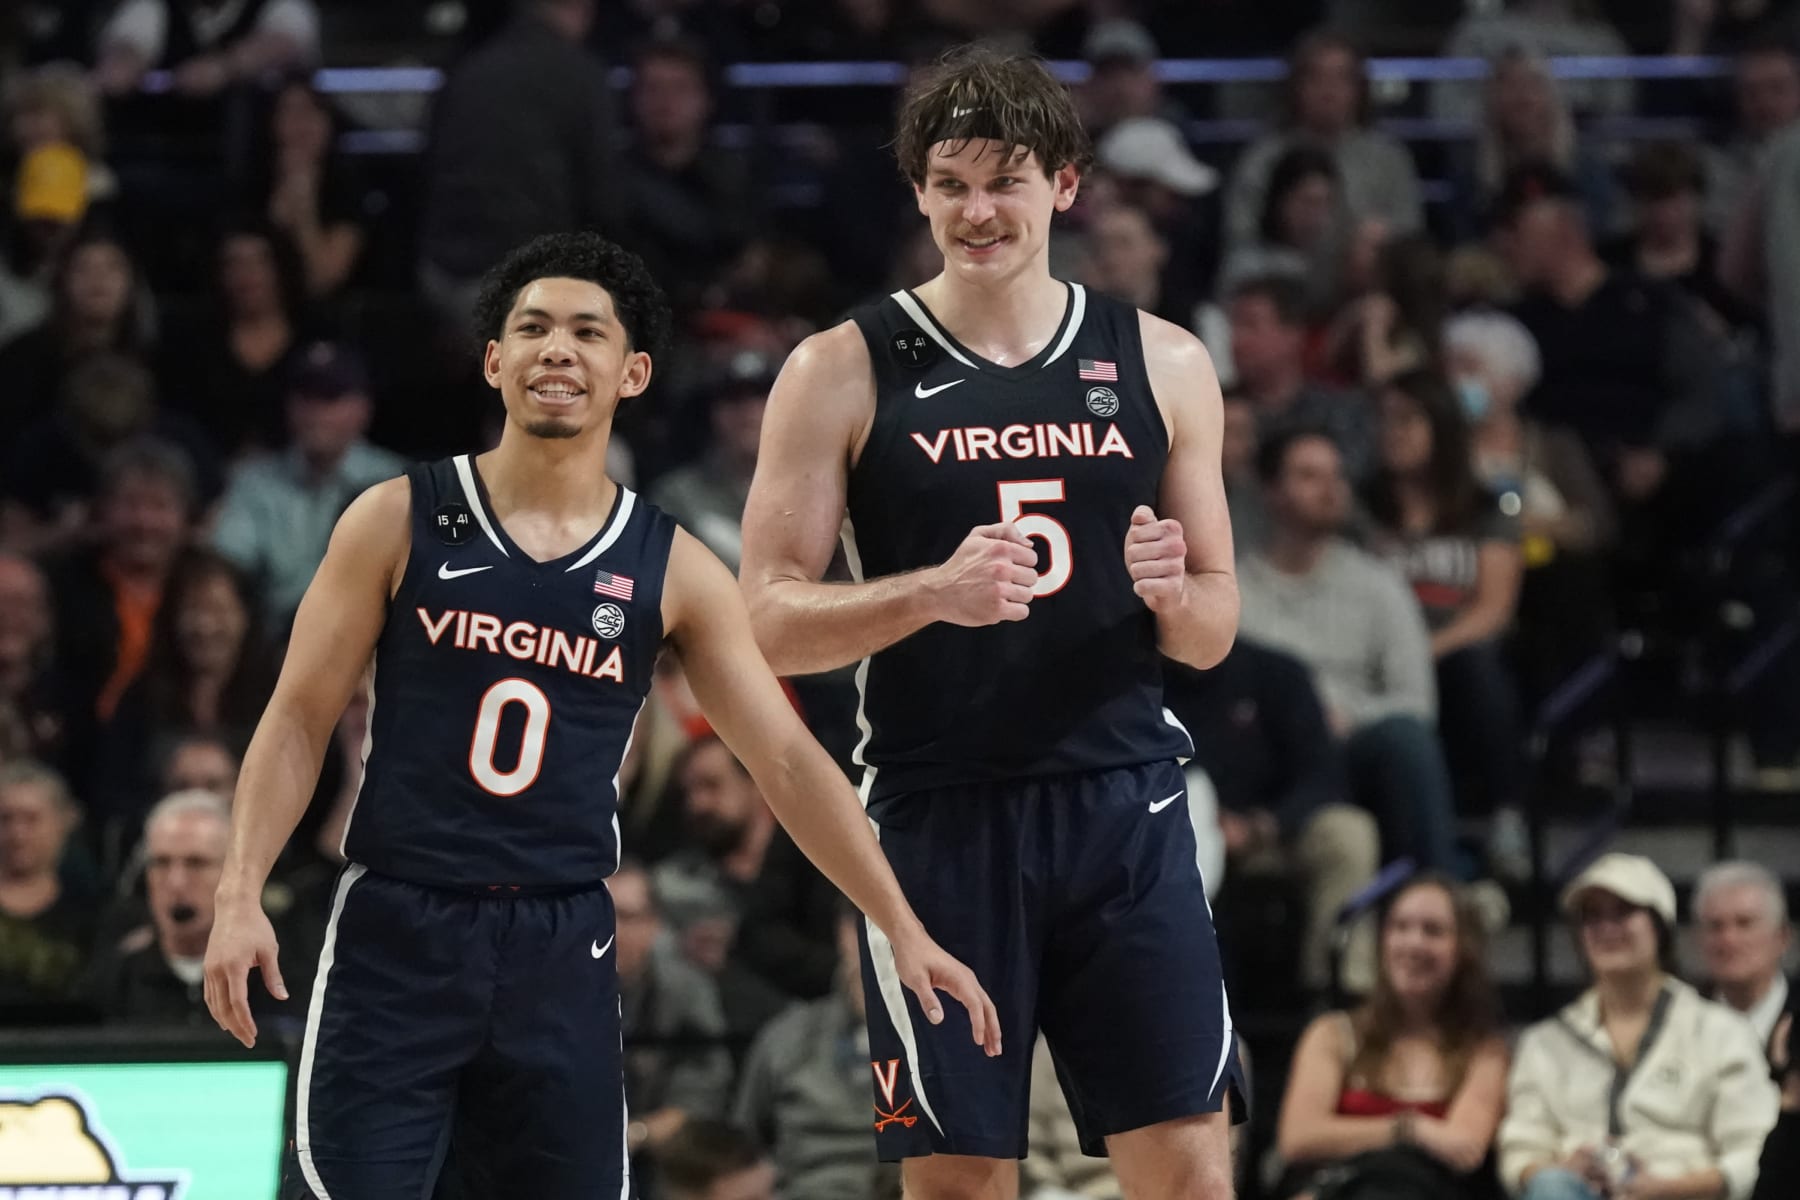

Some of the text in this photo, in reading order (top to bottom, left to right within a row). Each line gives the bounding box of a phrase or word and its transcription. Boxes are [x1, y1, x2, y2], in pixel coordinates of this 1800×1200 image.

[896, 337, 926, 350] 15 41
[910, 422, 1134, 464] VIRGINIA
[438, 513, 469, 526] 15 41
[997, 477, 1074, 598] 5
[416, 607, 624, 683] VIRGINIA
[468, 677, 551, 797] 0
[871, 1059, 900, 1112] V
